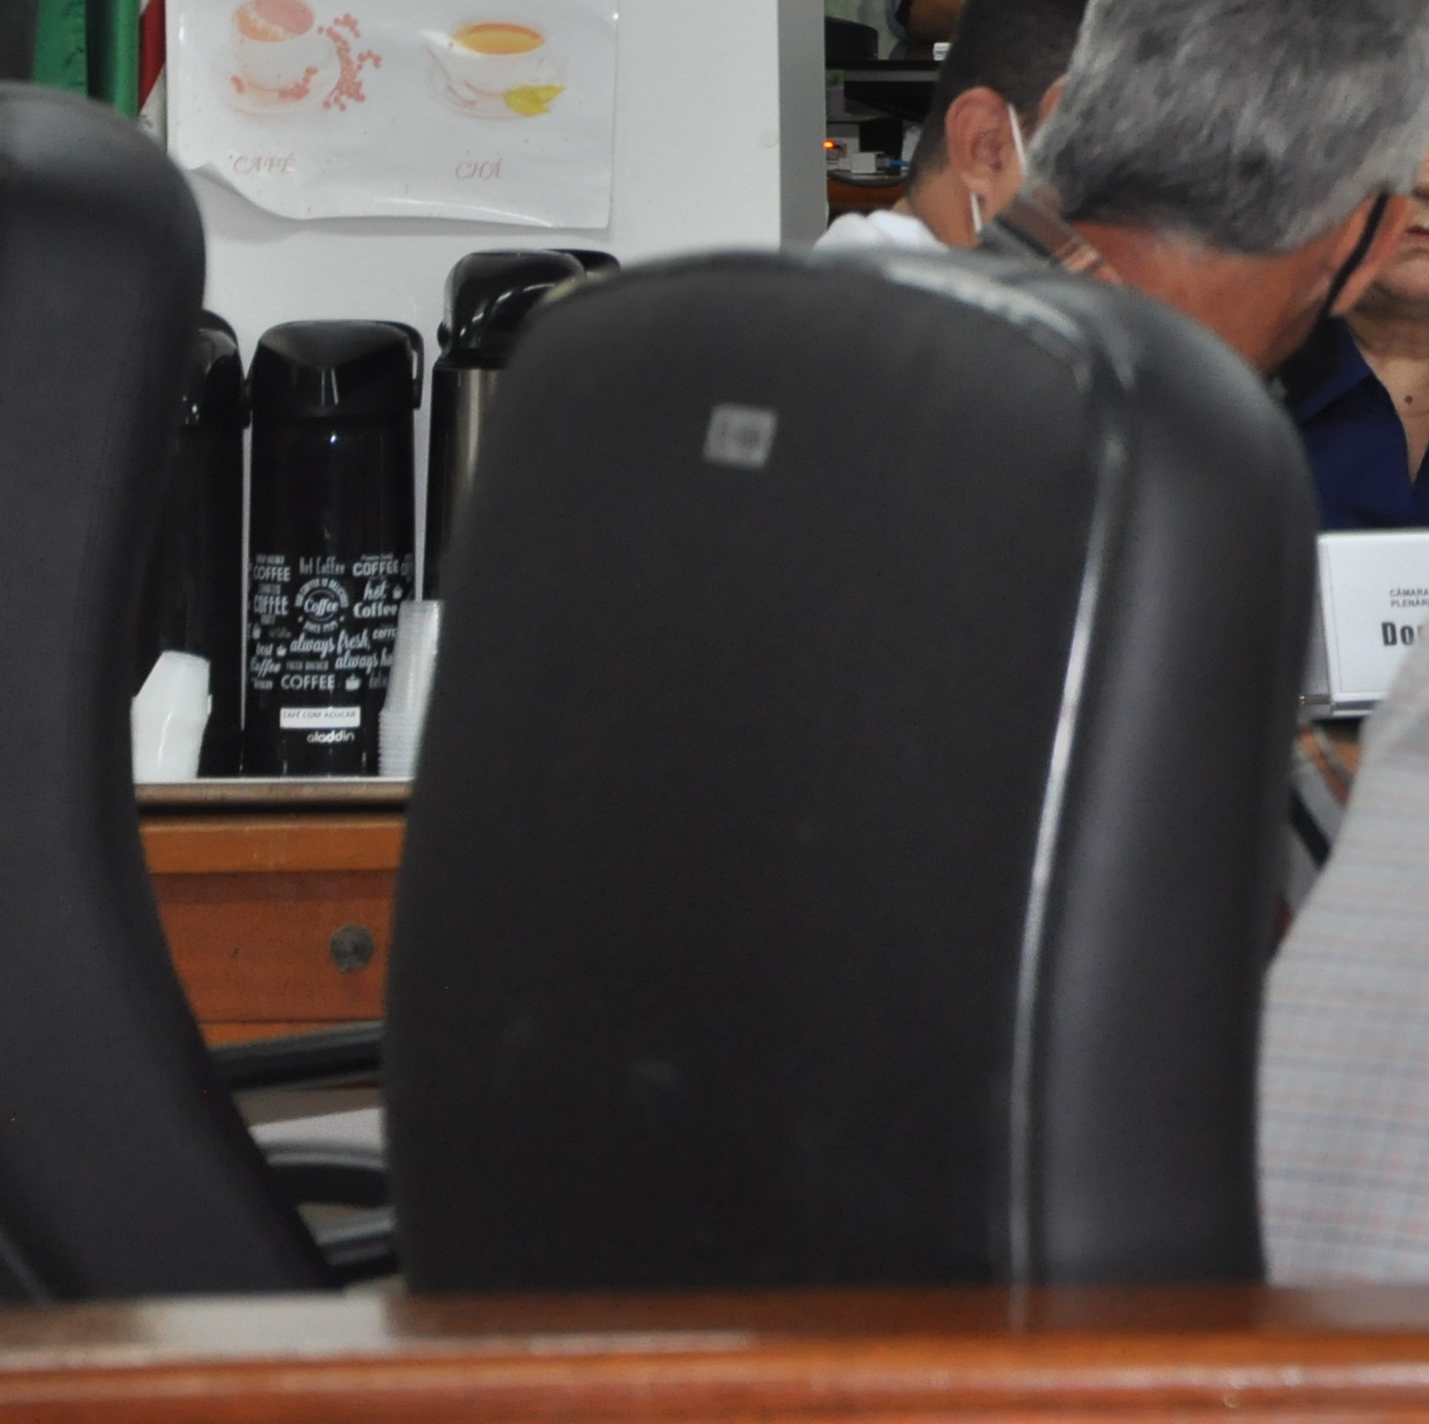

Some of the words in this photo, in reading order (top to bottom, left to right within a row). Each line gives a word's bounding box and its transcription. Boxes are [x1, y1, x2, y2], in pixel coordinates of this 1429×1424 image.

[352, 560, 399, 577] COFFEE
[1381, 621, 1424, 647] Do
[281, 674, 336, 690] COFFEE
[306, 730, 355, 744] aladdin
